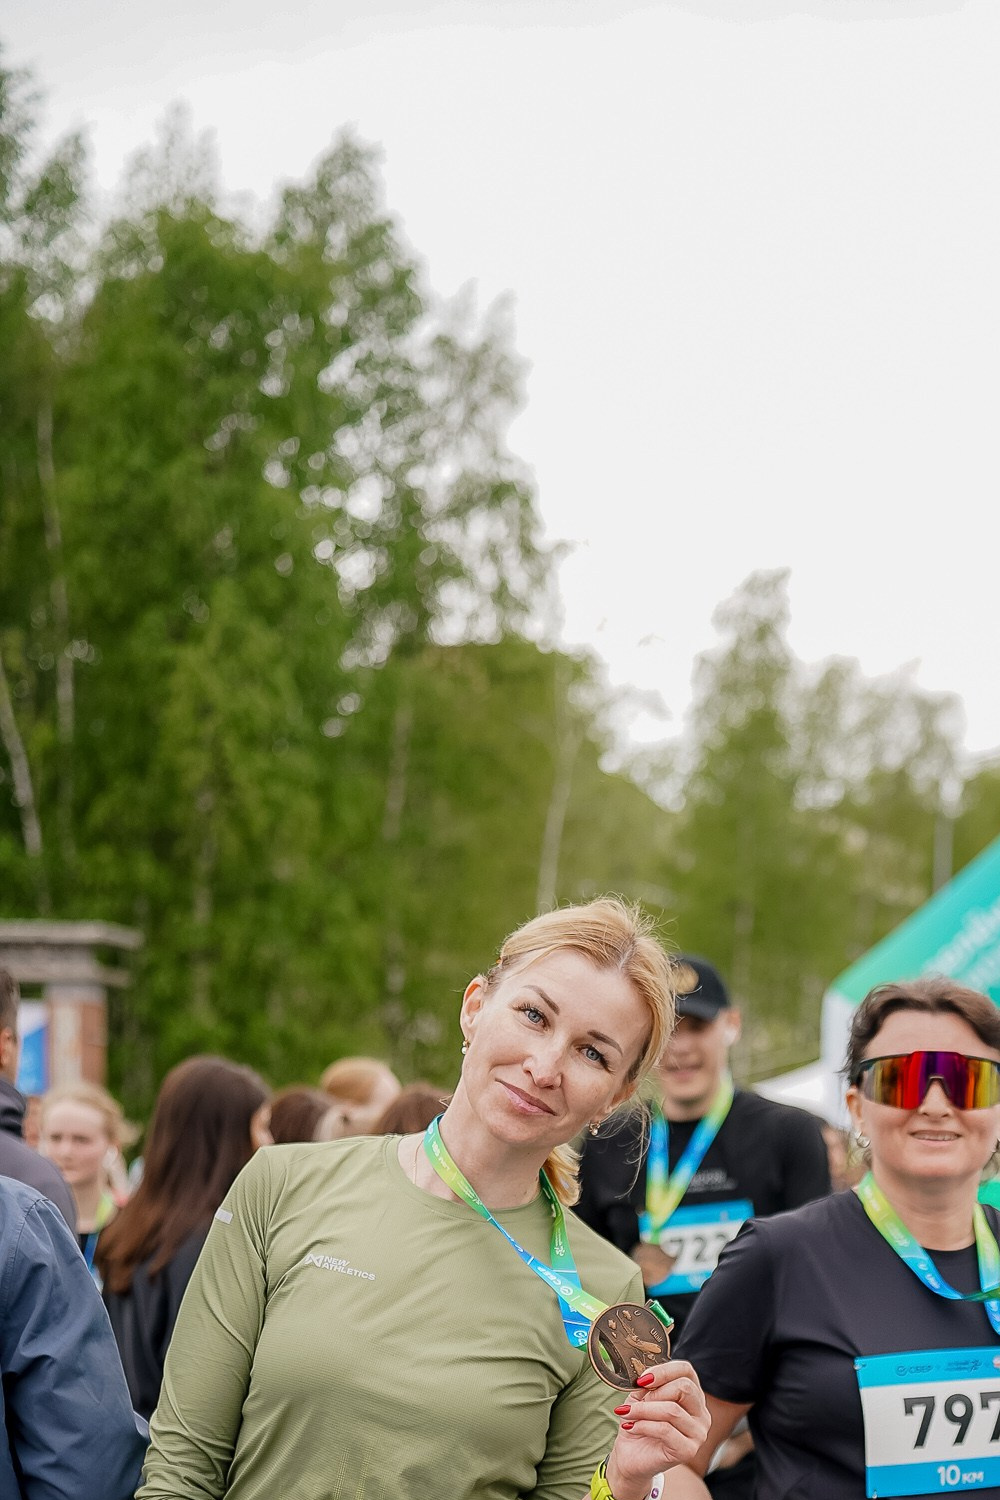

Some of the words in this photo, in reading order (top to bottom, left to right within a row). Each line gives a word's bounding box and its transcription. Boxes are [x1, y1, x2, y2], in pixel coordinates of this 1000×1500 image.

[324, 1255, 350, 1267] NEW
[321, 1263, 376, 1281] ATHLETICS
[937, 1465, 961, 1487] 10
